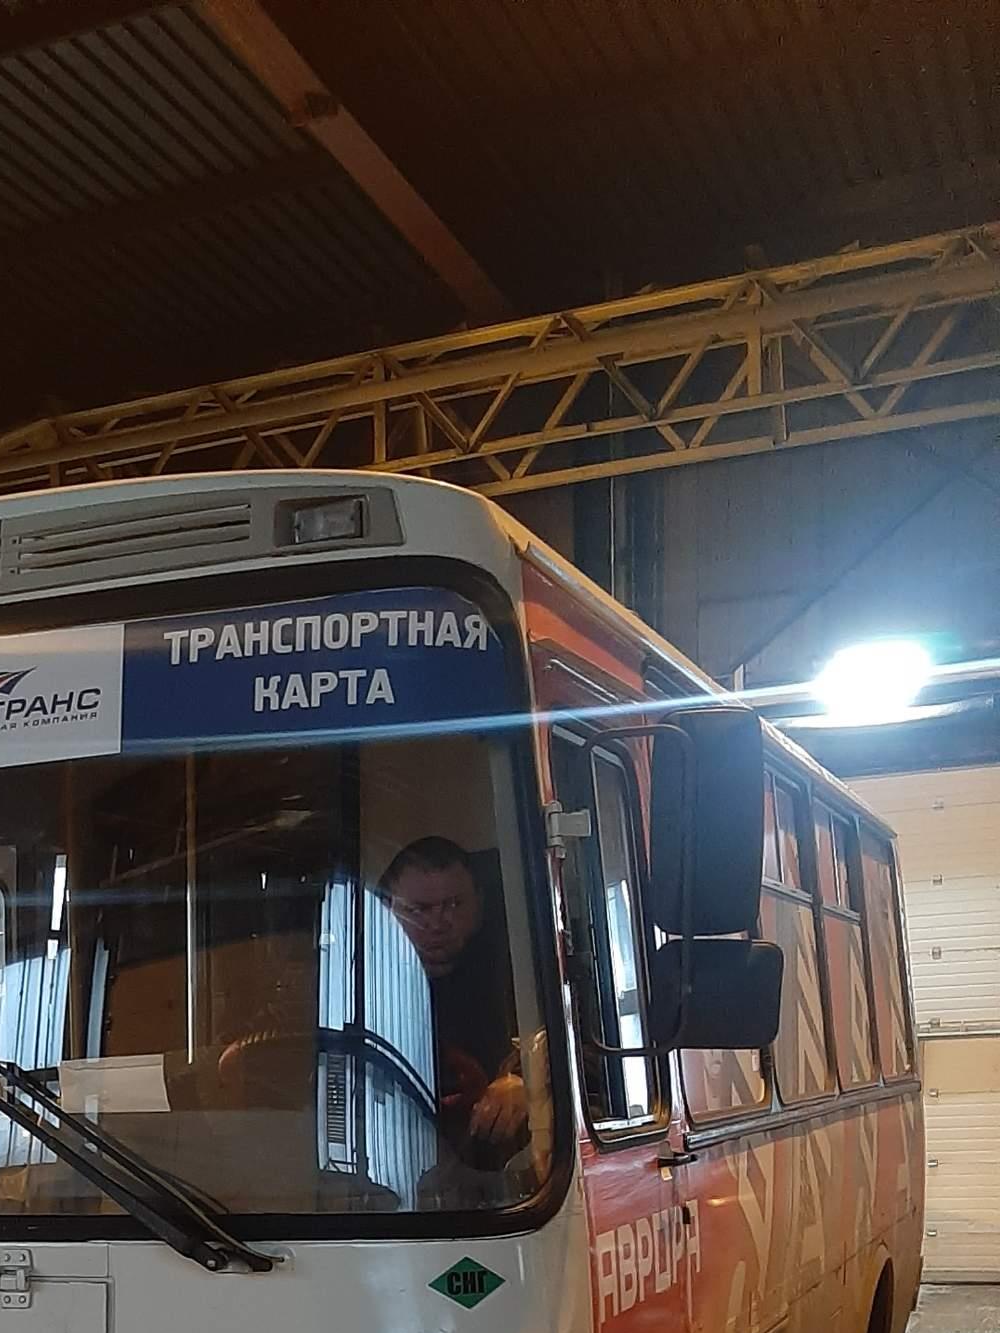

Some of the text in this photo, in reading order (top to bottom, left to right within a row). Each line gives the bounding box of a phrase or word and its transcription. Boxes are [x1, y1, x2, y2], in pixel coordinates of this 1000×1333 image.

[163, 610, 490, 666] ТРАНСПОРТНАЯ
[253, 668, 396, 713] КАРТА
[23, 712, 98, 728] КОМПАНИЯ
[595, 1199, 701, 1324] АВРОРА
